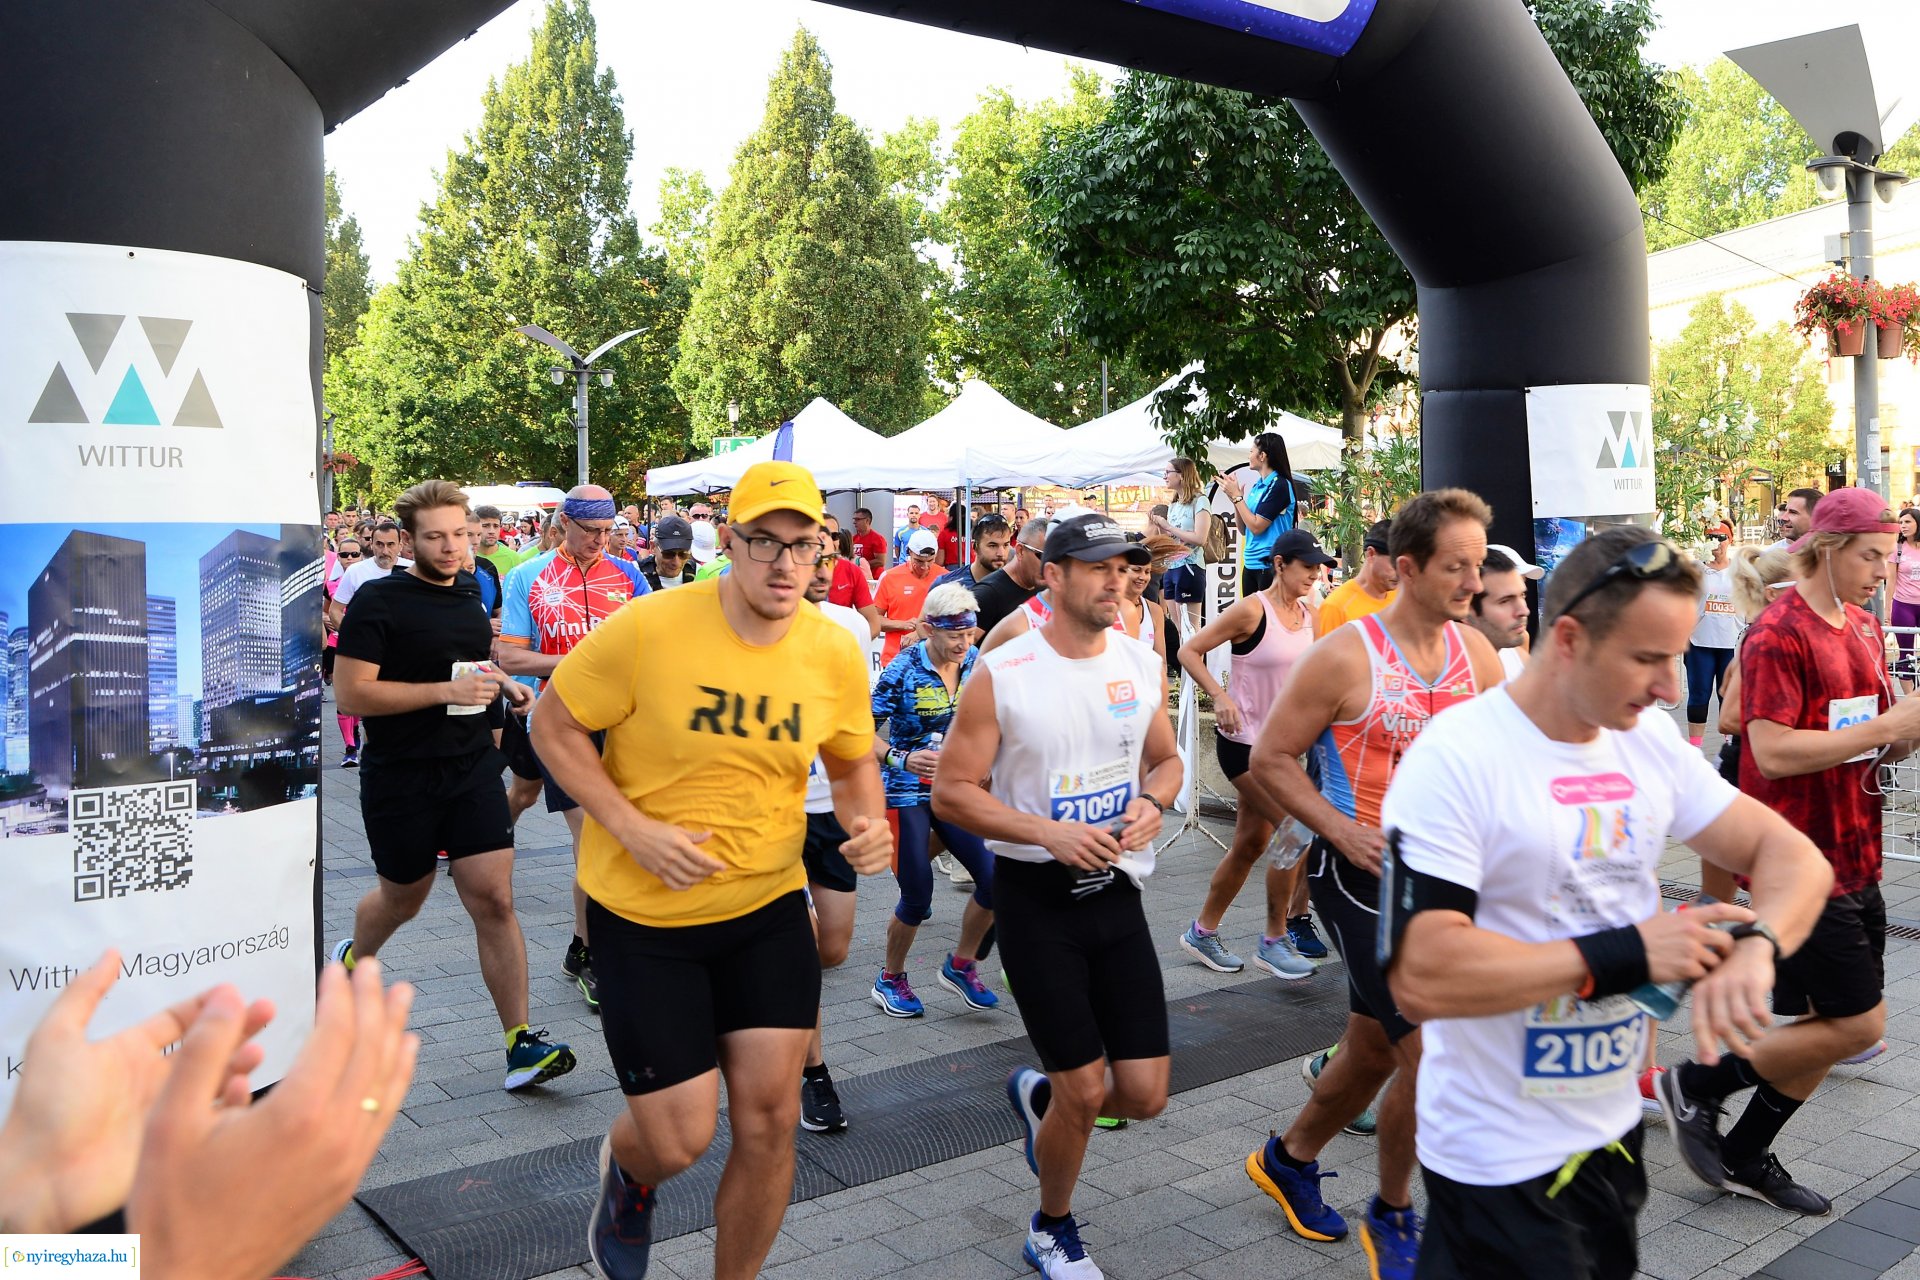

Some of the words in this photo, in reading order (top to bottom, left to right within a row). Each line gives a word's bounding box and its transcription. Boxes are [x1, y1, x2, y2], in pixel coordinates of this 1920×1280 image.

[78, 445, 184, 468] WITTUR
[1613, 478, 1644, 491] WITTUR
[1707, 602, 1736, 613] 10033
[689, 684, 801, 743] RUN
[1057, 787, 1128, 824] 21097
[9, 965, 92, 992] Witt
[117, 924, 290, 980] Magyarország
